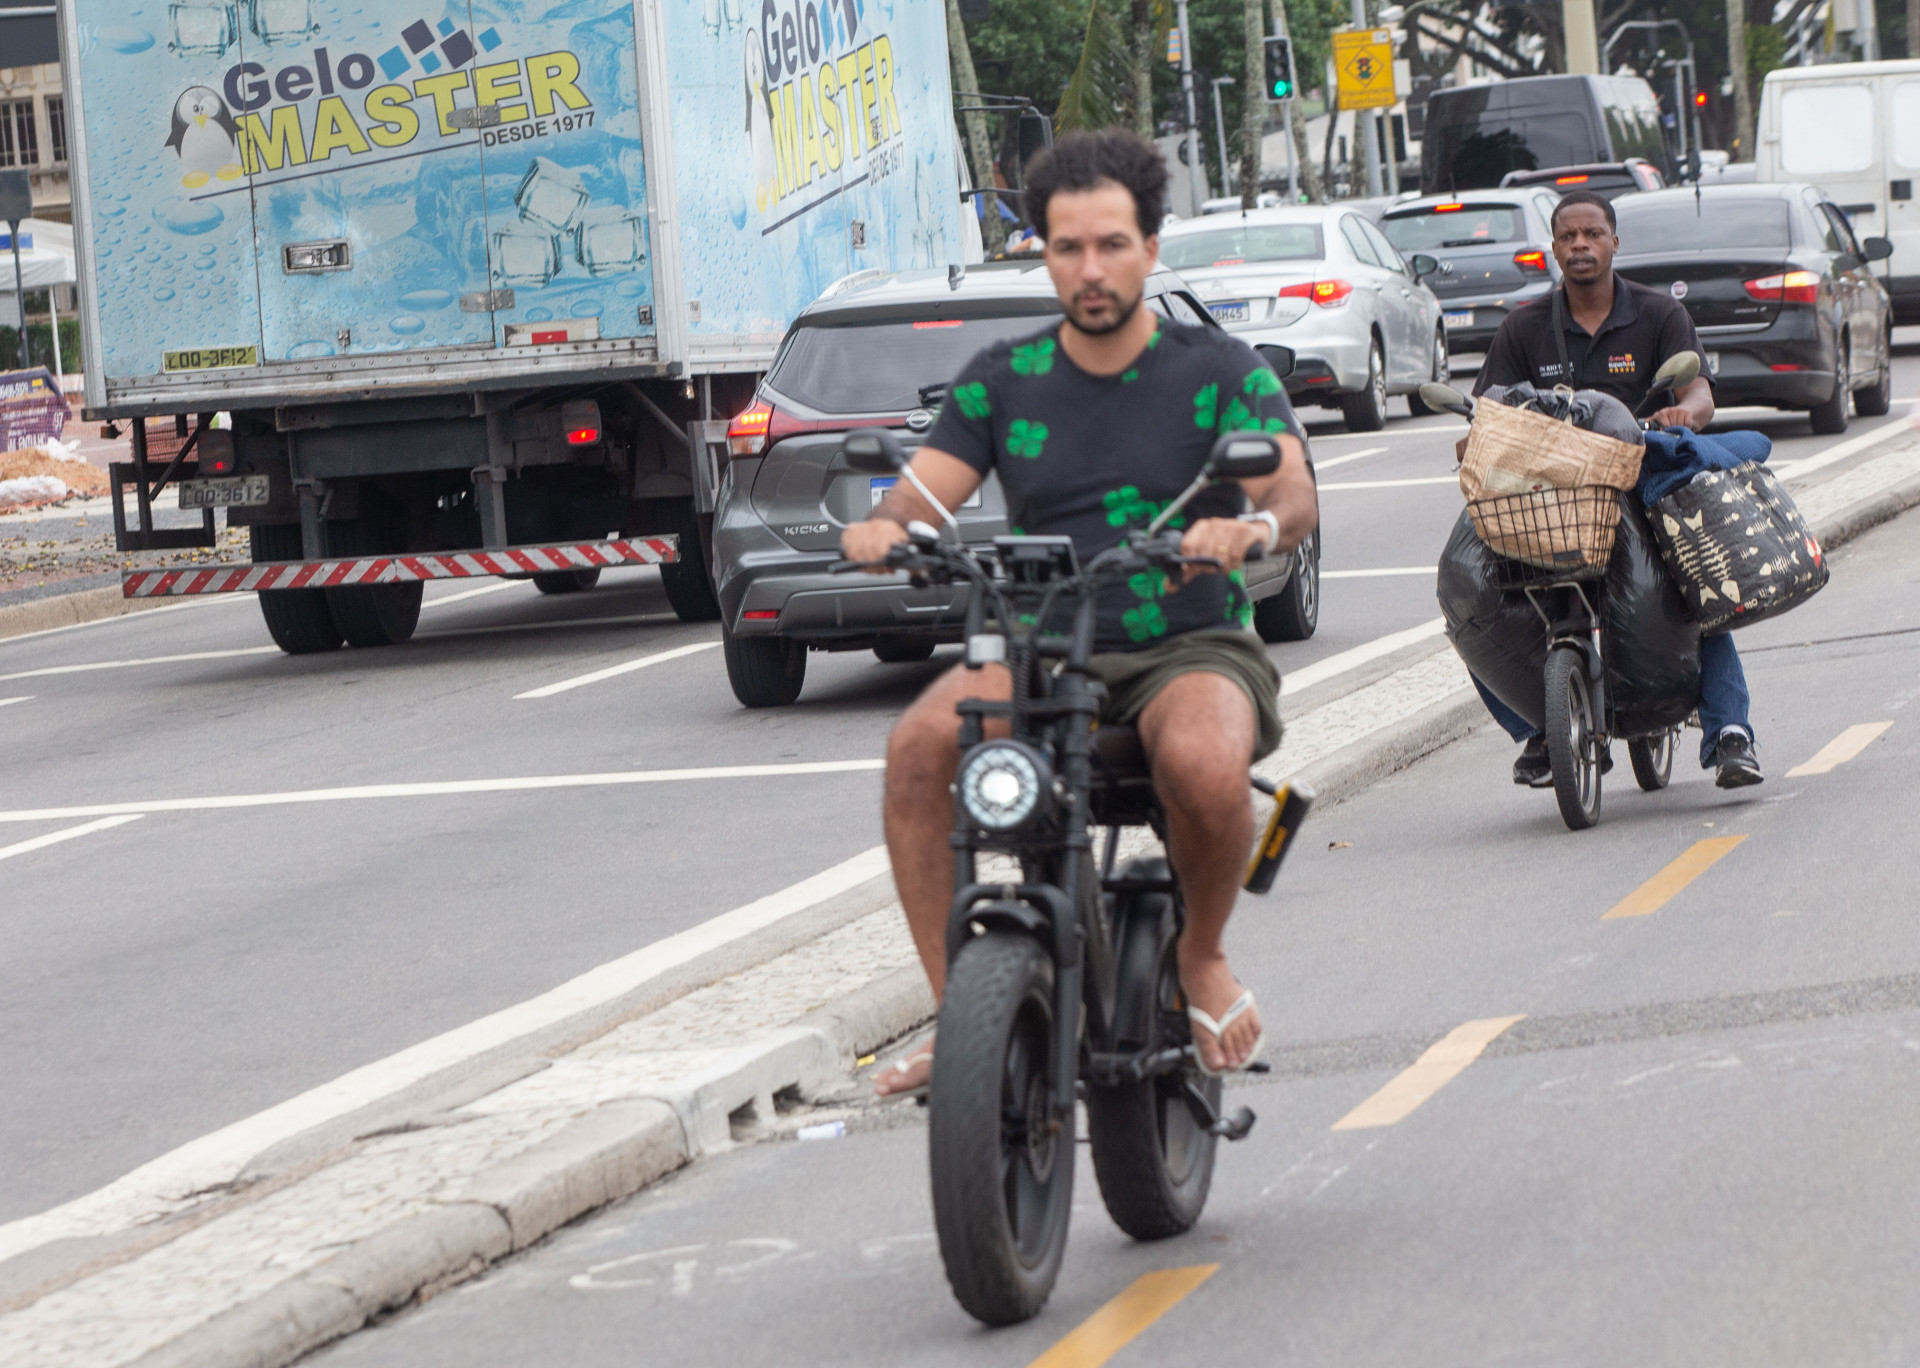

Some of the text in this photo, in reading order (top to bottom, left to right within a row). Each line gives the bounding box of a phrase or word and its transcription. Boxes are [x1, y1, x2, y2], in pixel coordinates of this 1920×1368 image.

[762, 0, 821, 83] Gelo
[223, 47, 375, 111] Gelo
[234, 50, 593, 176] MASTER
[483, 111, 595, 147] DESDE 1977
[769, 33, 902, 200] MASTER
[784, 524, 829, 536] KICKS
